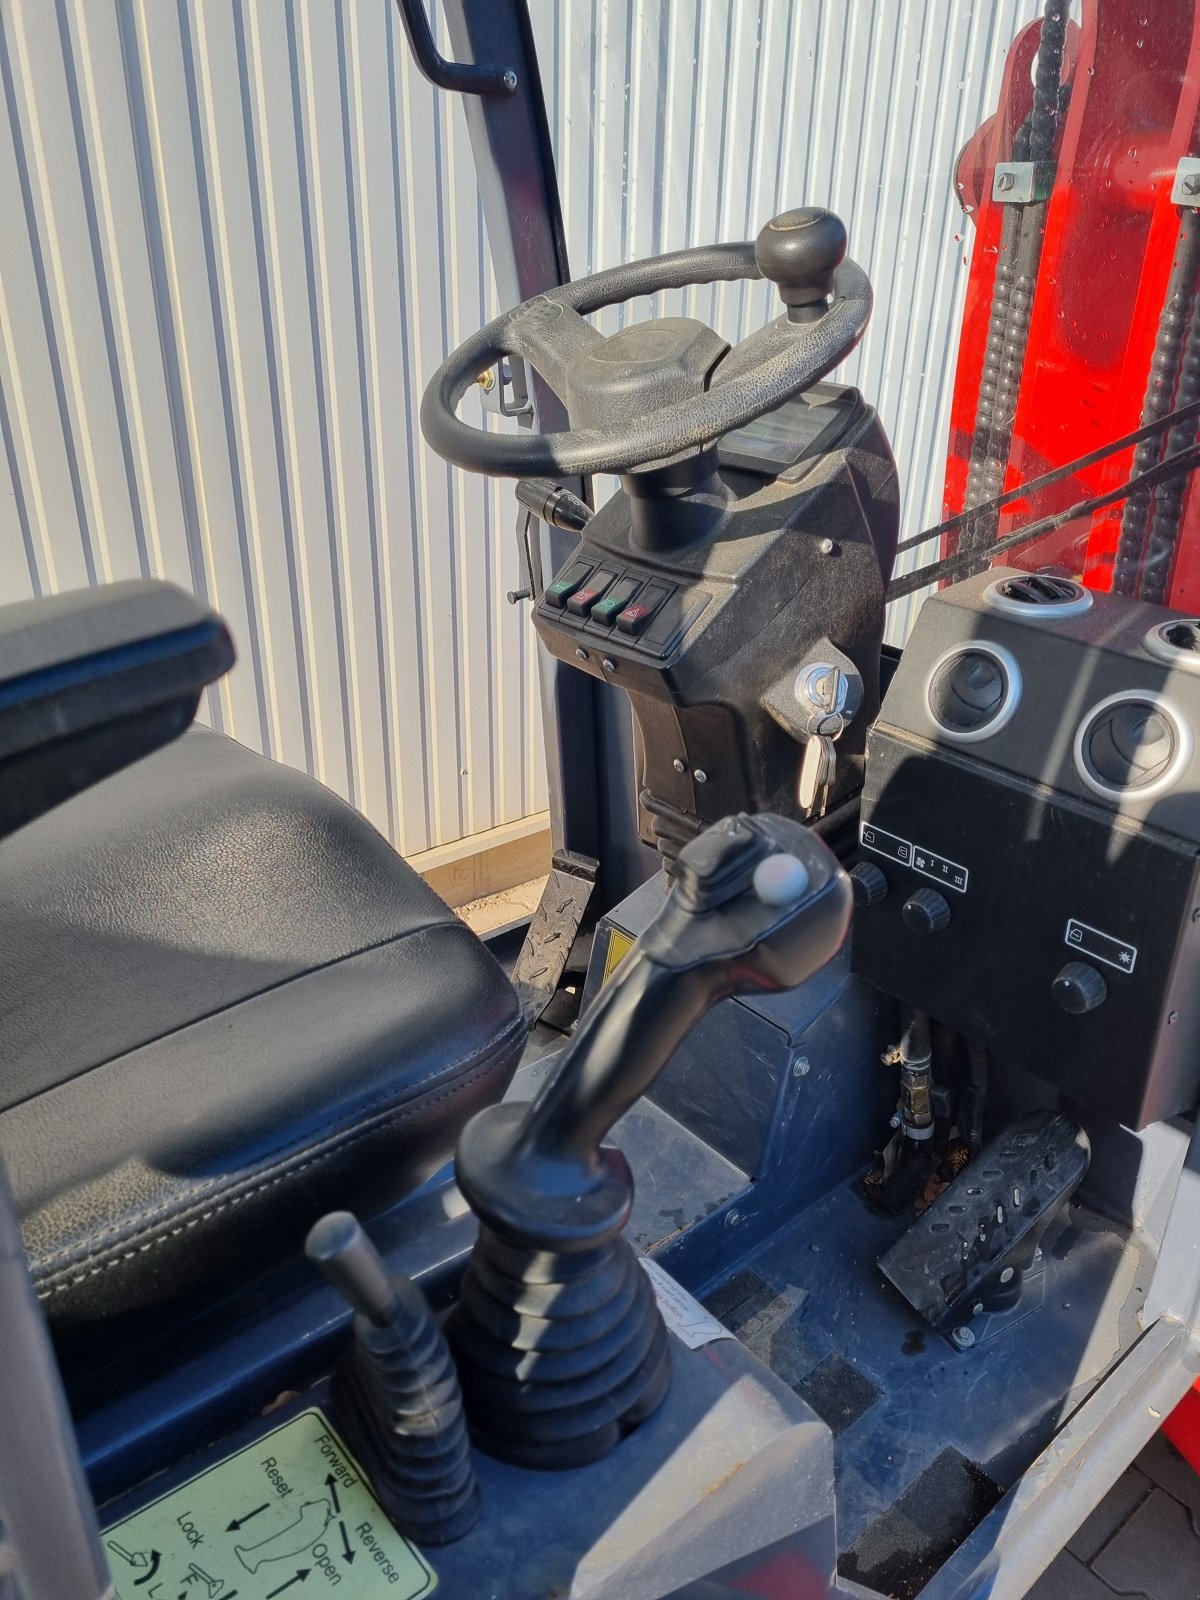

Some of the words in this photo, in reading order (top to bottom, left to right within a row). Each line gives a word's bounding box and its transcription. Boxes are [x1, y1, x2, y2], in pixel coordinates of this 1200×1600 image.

[261, 1456, 294, 1499] Reset
[314, 1434, 359, 1489] Forward
[176, 1511, 205, 1549] Lock
[312, 1543, 342, 1586] Open
[355, 1521, 400, 1584] Reverse
